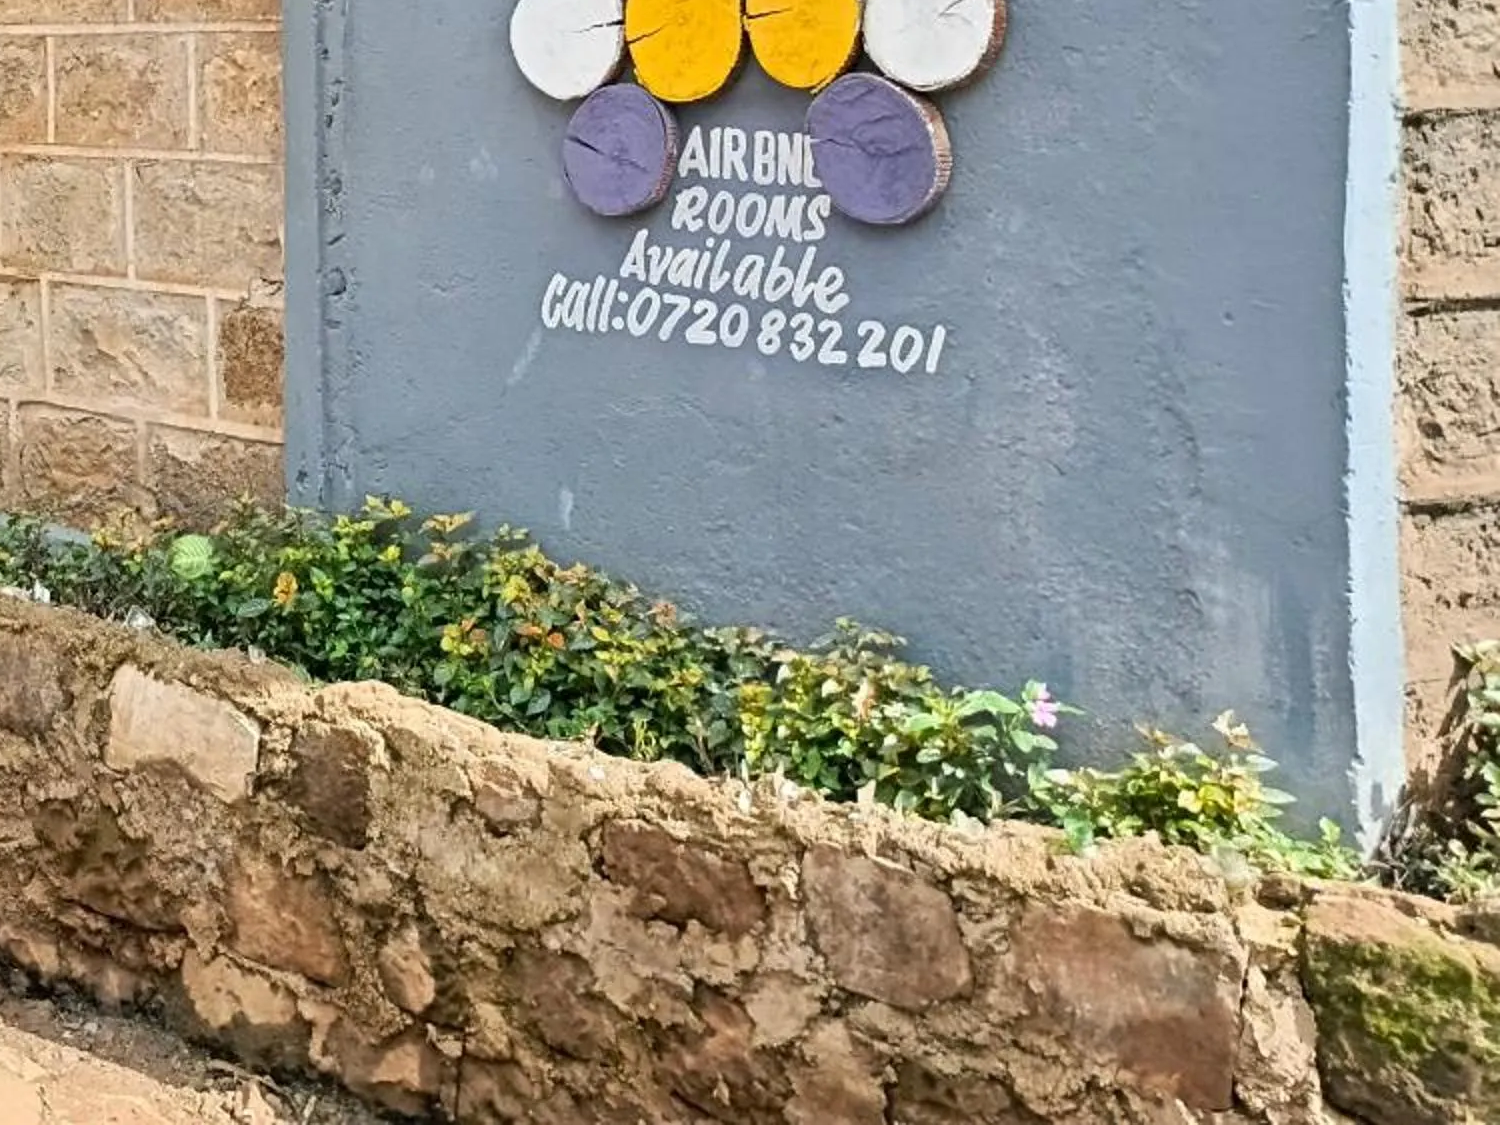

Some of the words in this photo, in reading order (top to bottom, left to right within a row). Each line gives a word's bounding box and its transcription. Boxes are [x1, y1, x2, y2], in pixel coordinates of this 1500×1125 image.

[672, 187, 831, 242] ROOMS
[620, 229, 850, 314] Available
[857, 321, 945, 373] 201
